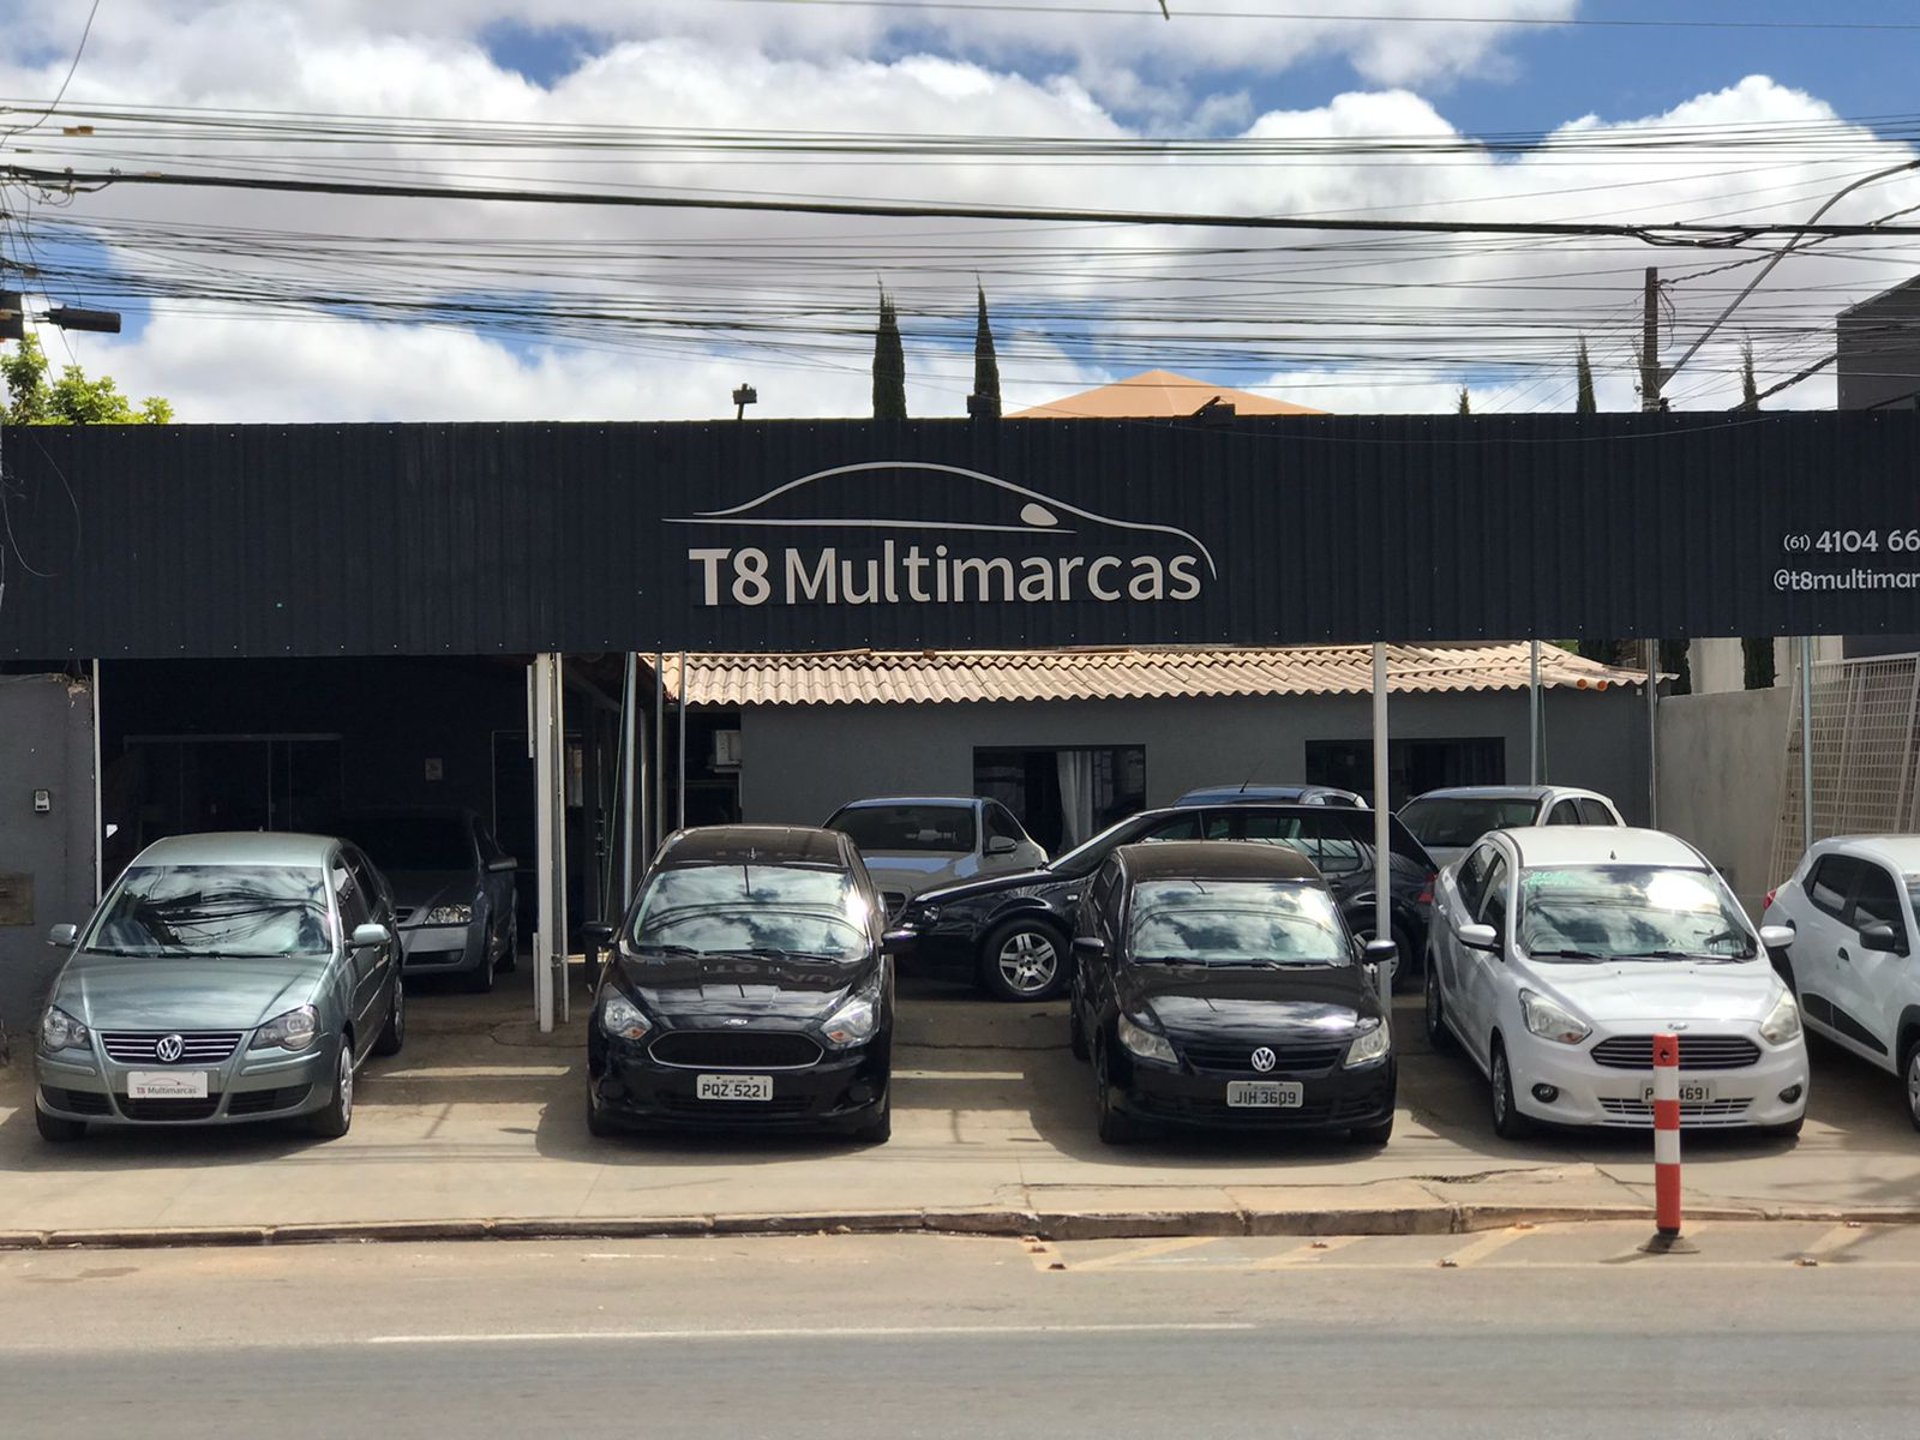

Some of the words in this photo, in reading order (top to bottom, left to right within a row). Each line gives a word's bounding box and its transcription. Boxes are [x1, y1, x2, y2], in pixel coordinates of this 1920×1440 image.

[1783, 534, 1811, 551] (61)
[1815, 530, 1879, 552] 4104
[1887, 529, 1920, 552] 66
[688, 546, 771, 606] T8
[784, 539, 1201, 605] Multimarcas
[1773, 568, 1920, 590] @t8multimar
[147, 1086, 197, 1095] Multimarcas
